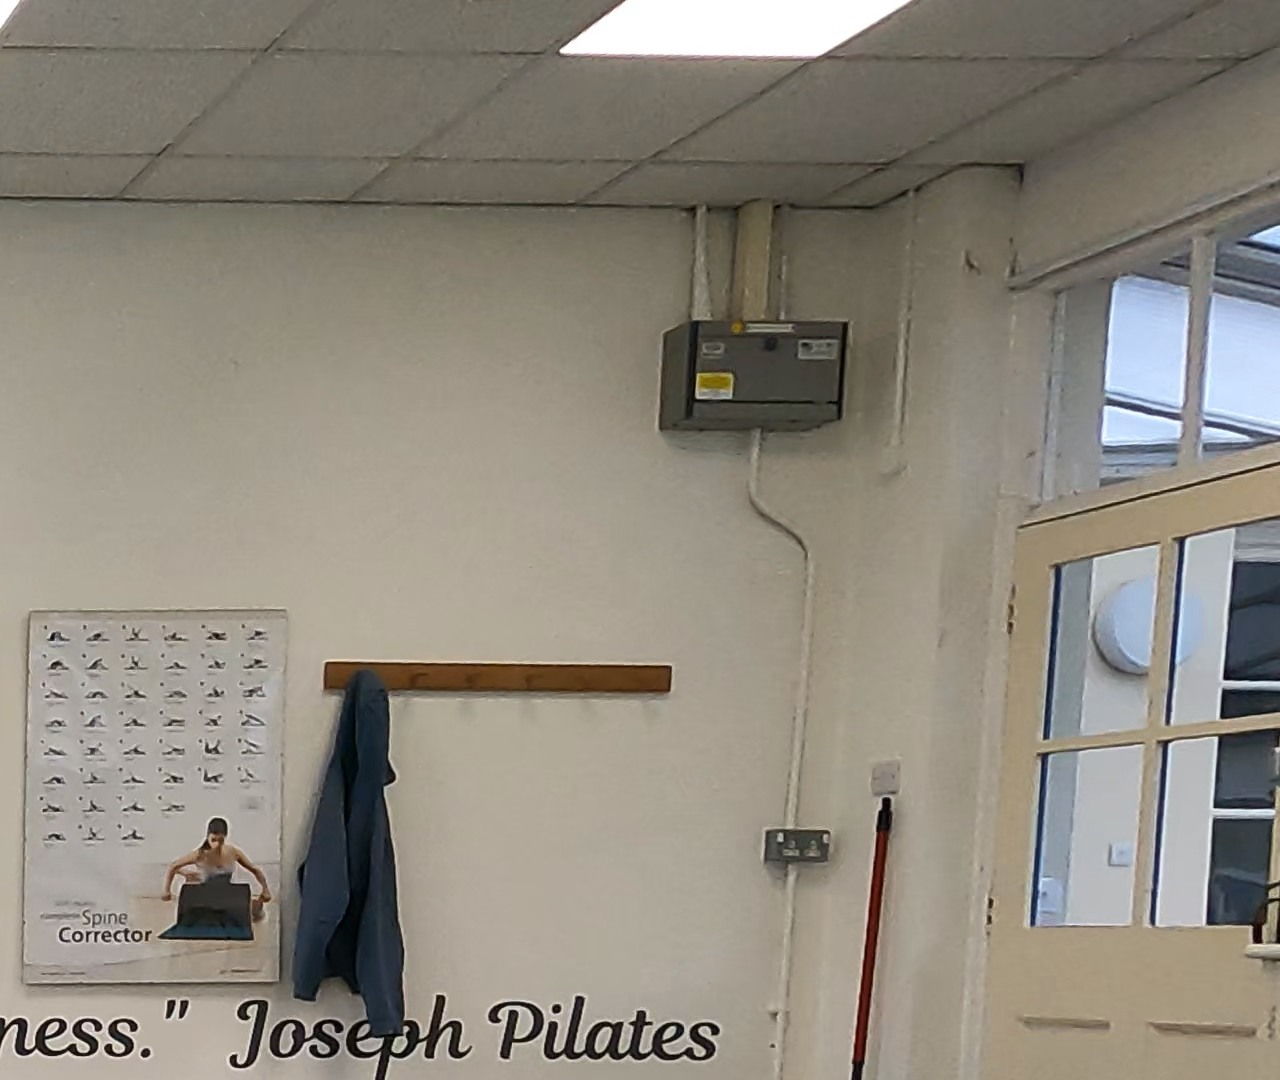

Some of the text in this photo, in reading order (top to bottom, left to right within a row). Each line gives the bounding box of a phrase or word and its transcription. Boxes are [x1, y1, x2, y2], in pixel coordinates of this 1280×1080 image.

[82, 909, 128, 928] Spine
[58, 926, 153, 943] Corrector
[488, 995, 721, 1062] Pilates
